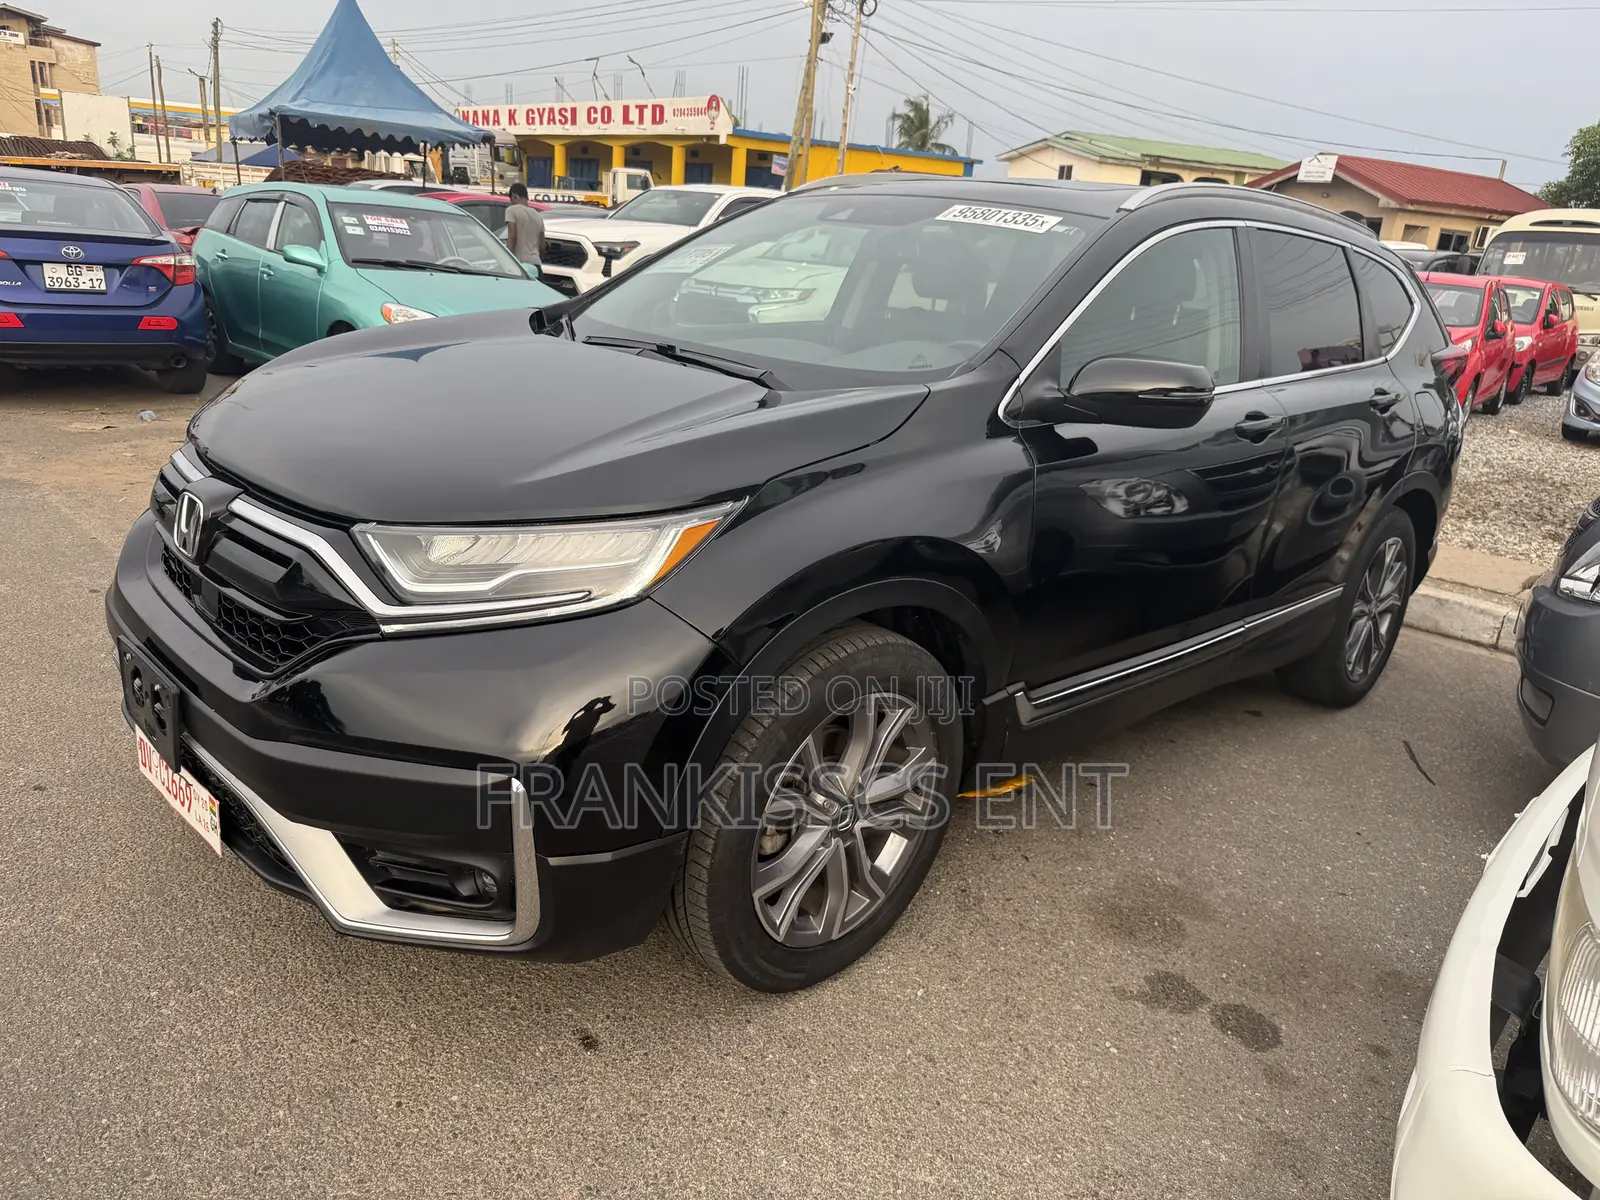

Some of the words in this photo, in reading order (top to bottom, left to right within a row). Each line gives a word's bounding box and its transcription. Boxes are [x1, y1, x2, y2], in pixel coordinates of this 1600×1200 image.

[461, 108, 501, 126] NANA
[526, 107, 577, 126] GYASI
[66, 265, 83, 277] GG
[48, 276, 103, 289] 3963-17
[139, 737, 152, 773] DV
